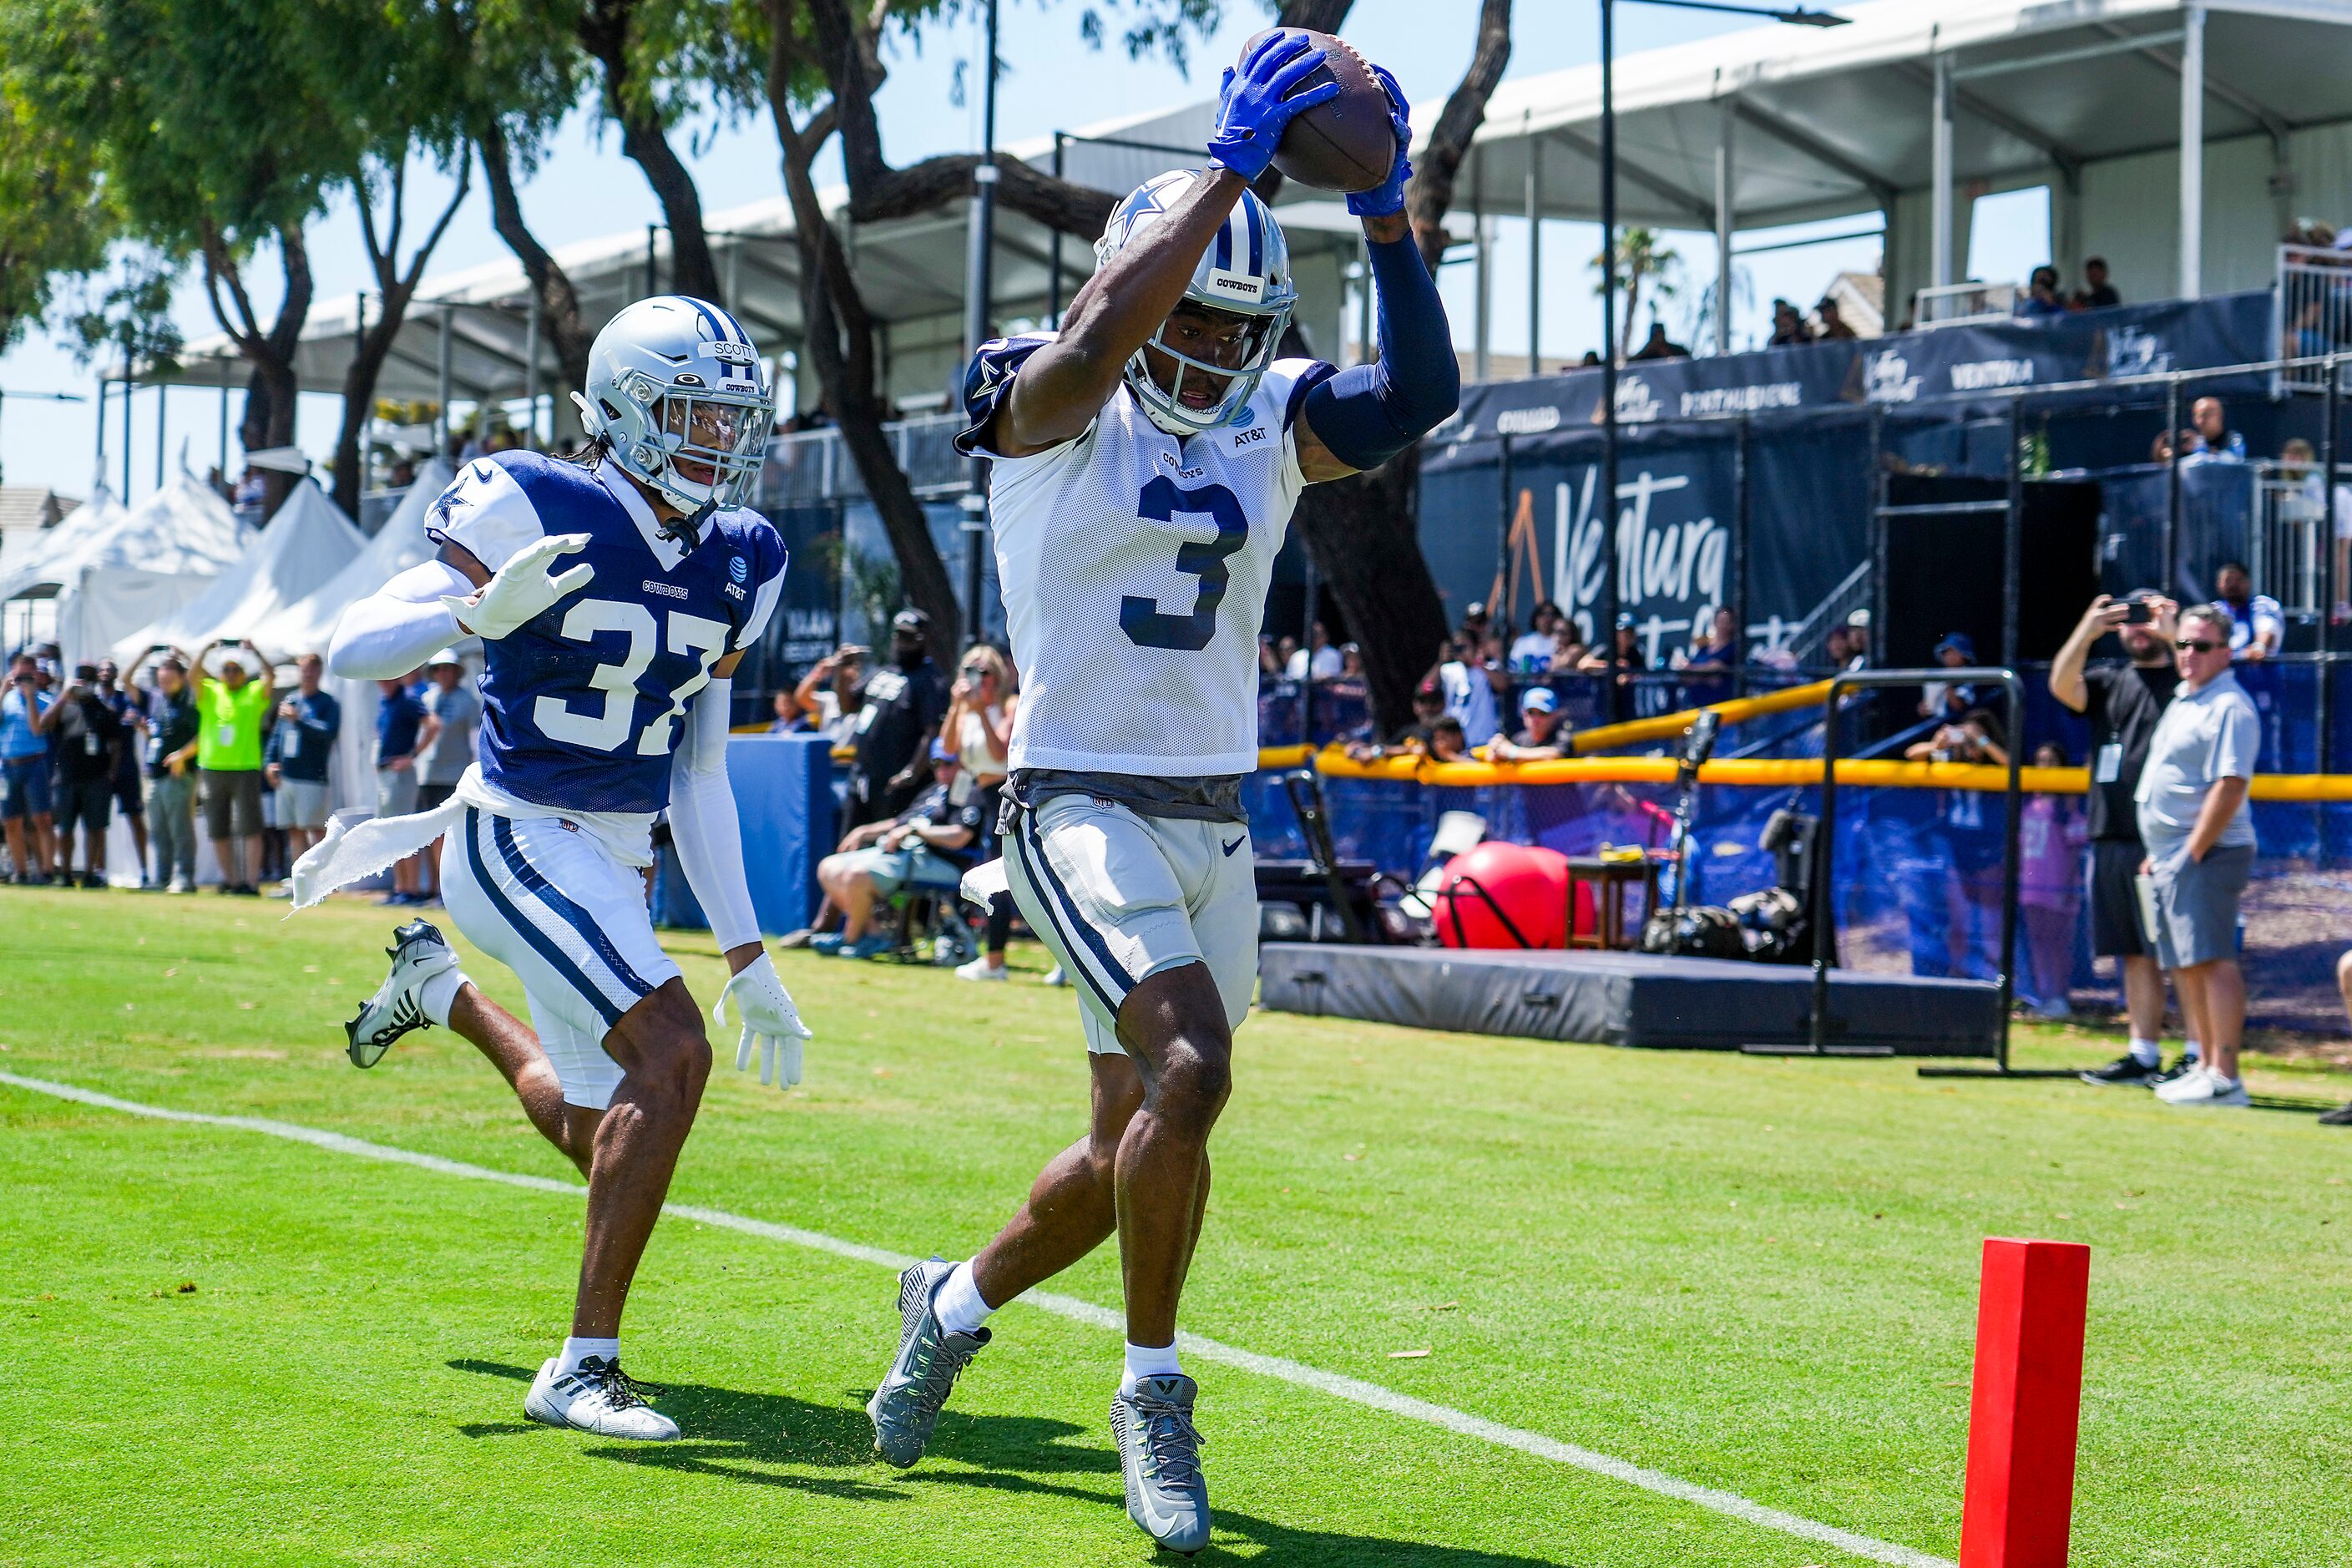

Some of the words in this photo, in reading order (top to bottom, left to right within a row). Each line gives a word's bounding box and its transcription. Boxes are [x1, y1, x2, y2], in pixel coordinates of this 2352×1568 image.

[1216, 277, 1258, 294] COWBOYS
[715, 342, 751, 357] SCOTT
[726, 383, 755, 393] COWBOYS
[1234, 427, 1267, 448] AT&T
[1119, 474, 1249, 651] 3
[642, 580, 689, 600] COWBOYS
[724, 582, 747, 601] AT&T
[533, 598, 732, 756] 37
